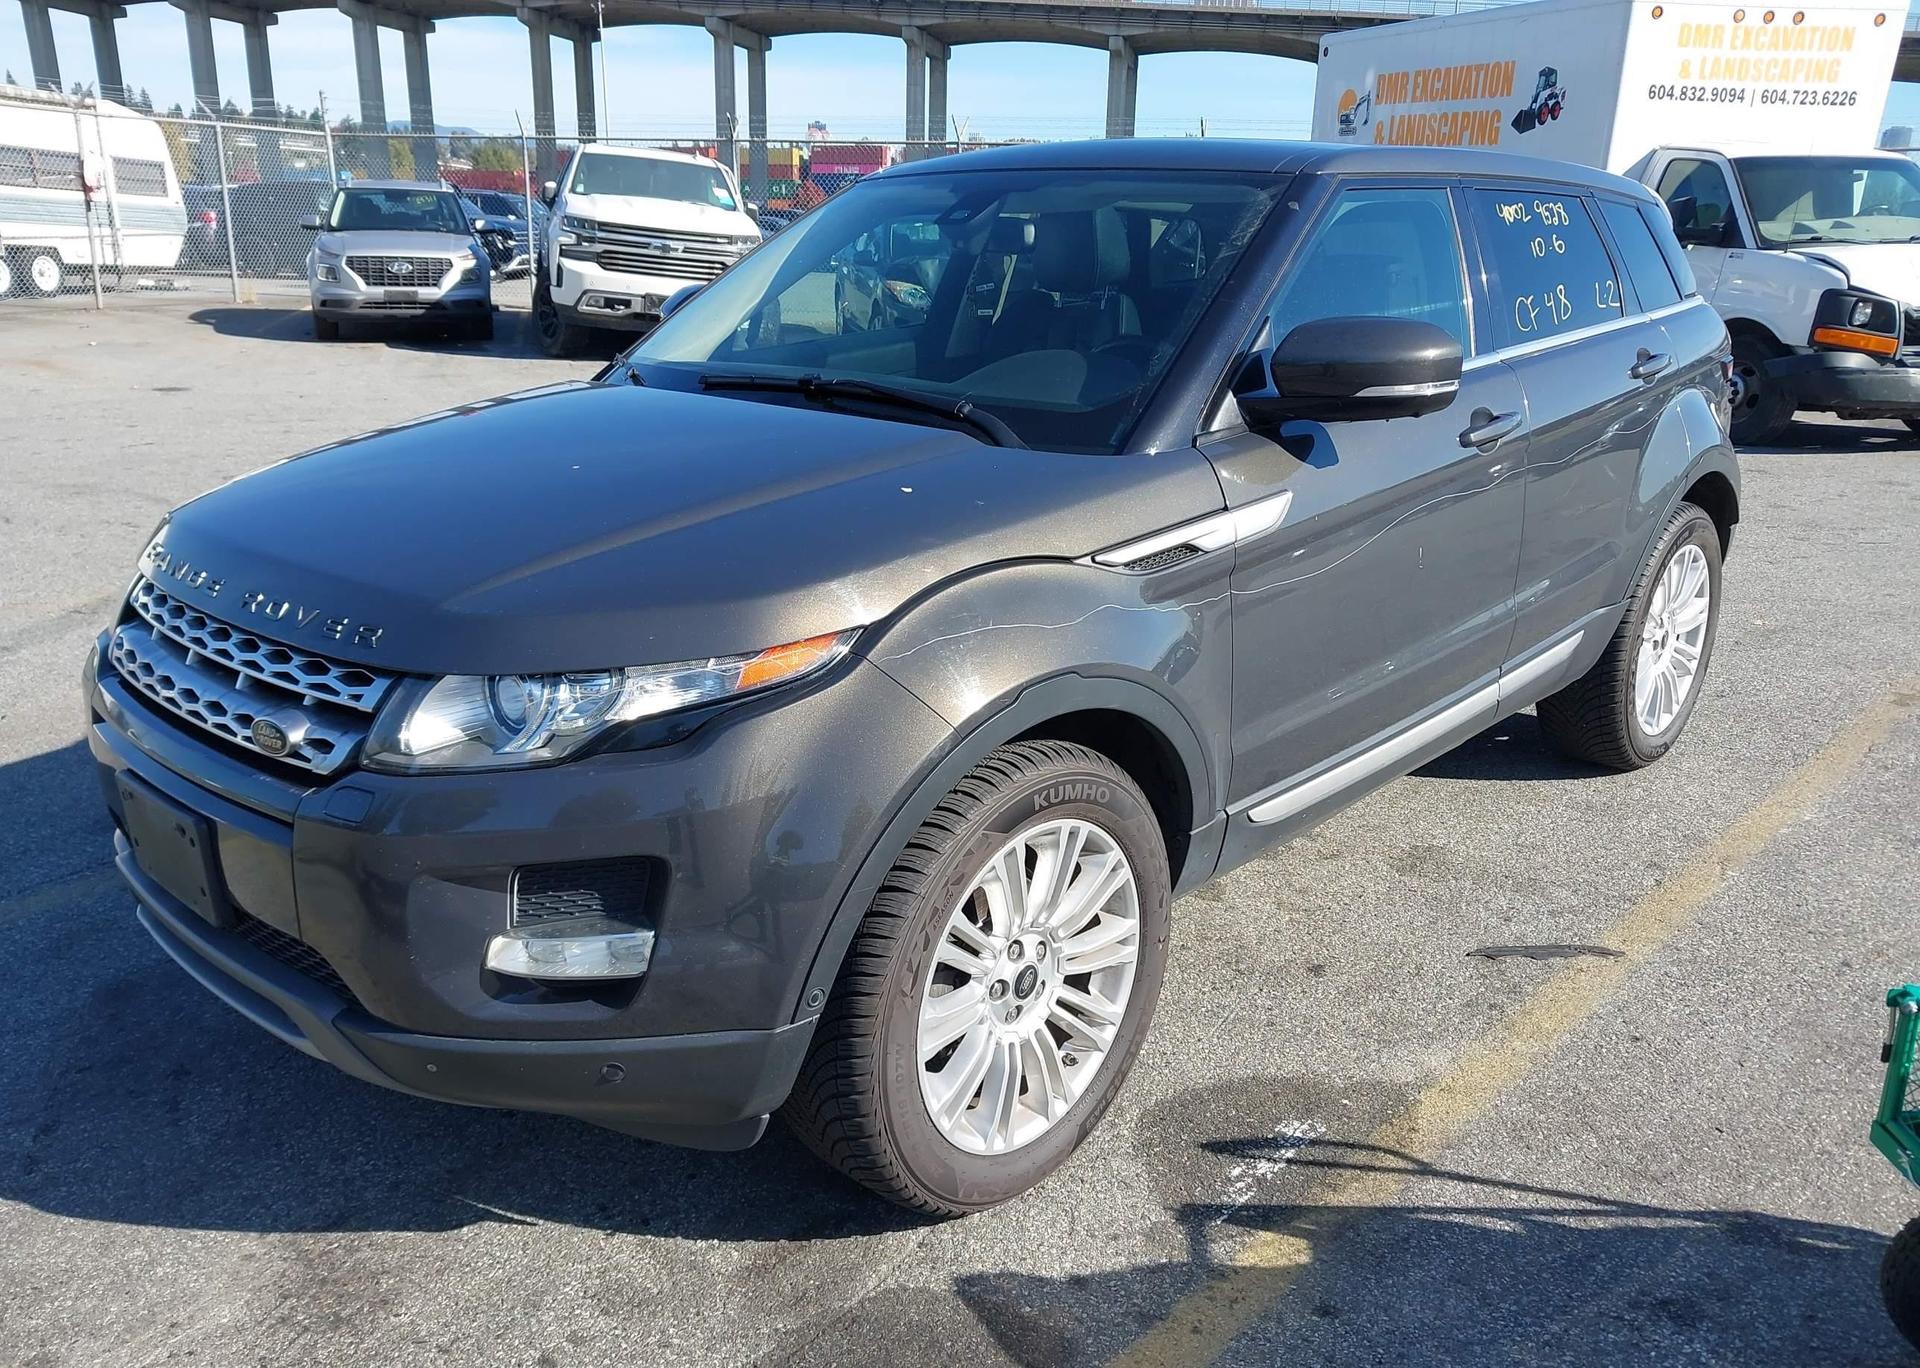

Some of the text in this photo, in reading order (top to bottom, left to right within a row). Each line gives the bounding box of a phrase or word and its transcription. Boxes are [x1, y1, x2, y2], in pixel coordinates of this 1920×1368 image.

[1676, 23, 1857, 51] DMR EXCAVATION
[1375, 60, 1517, 105] DMR EXCAVATION
[1679, 56, 1842, 83] & LANDSCAPING
[1648, 84, 1746, 104] 604.832.9094
[1760, 89, 1858, 106] 604.723.6226
[1374, 109, 1502, 146] & LANDSCAPING
[1543, 284, 1572, 326] 48
[147, 542, 384, 648] RANGE ROVER
[1033, 783, 1110, 811] KUMHO
